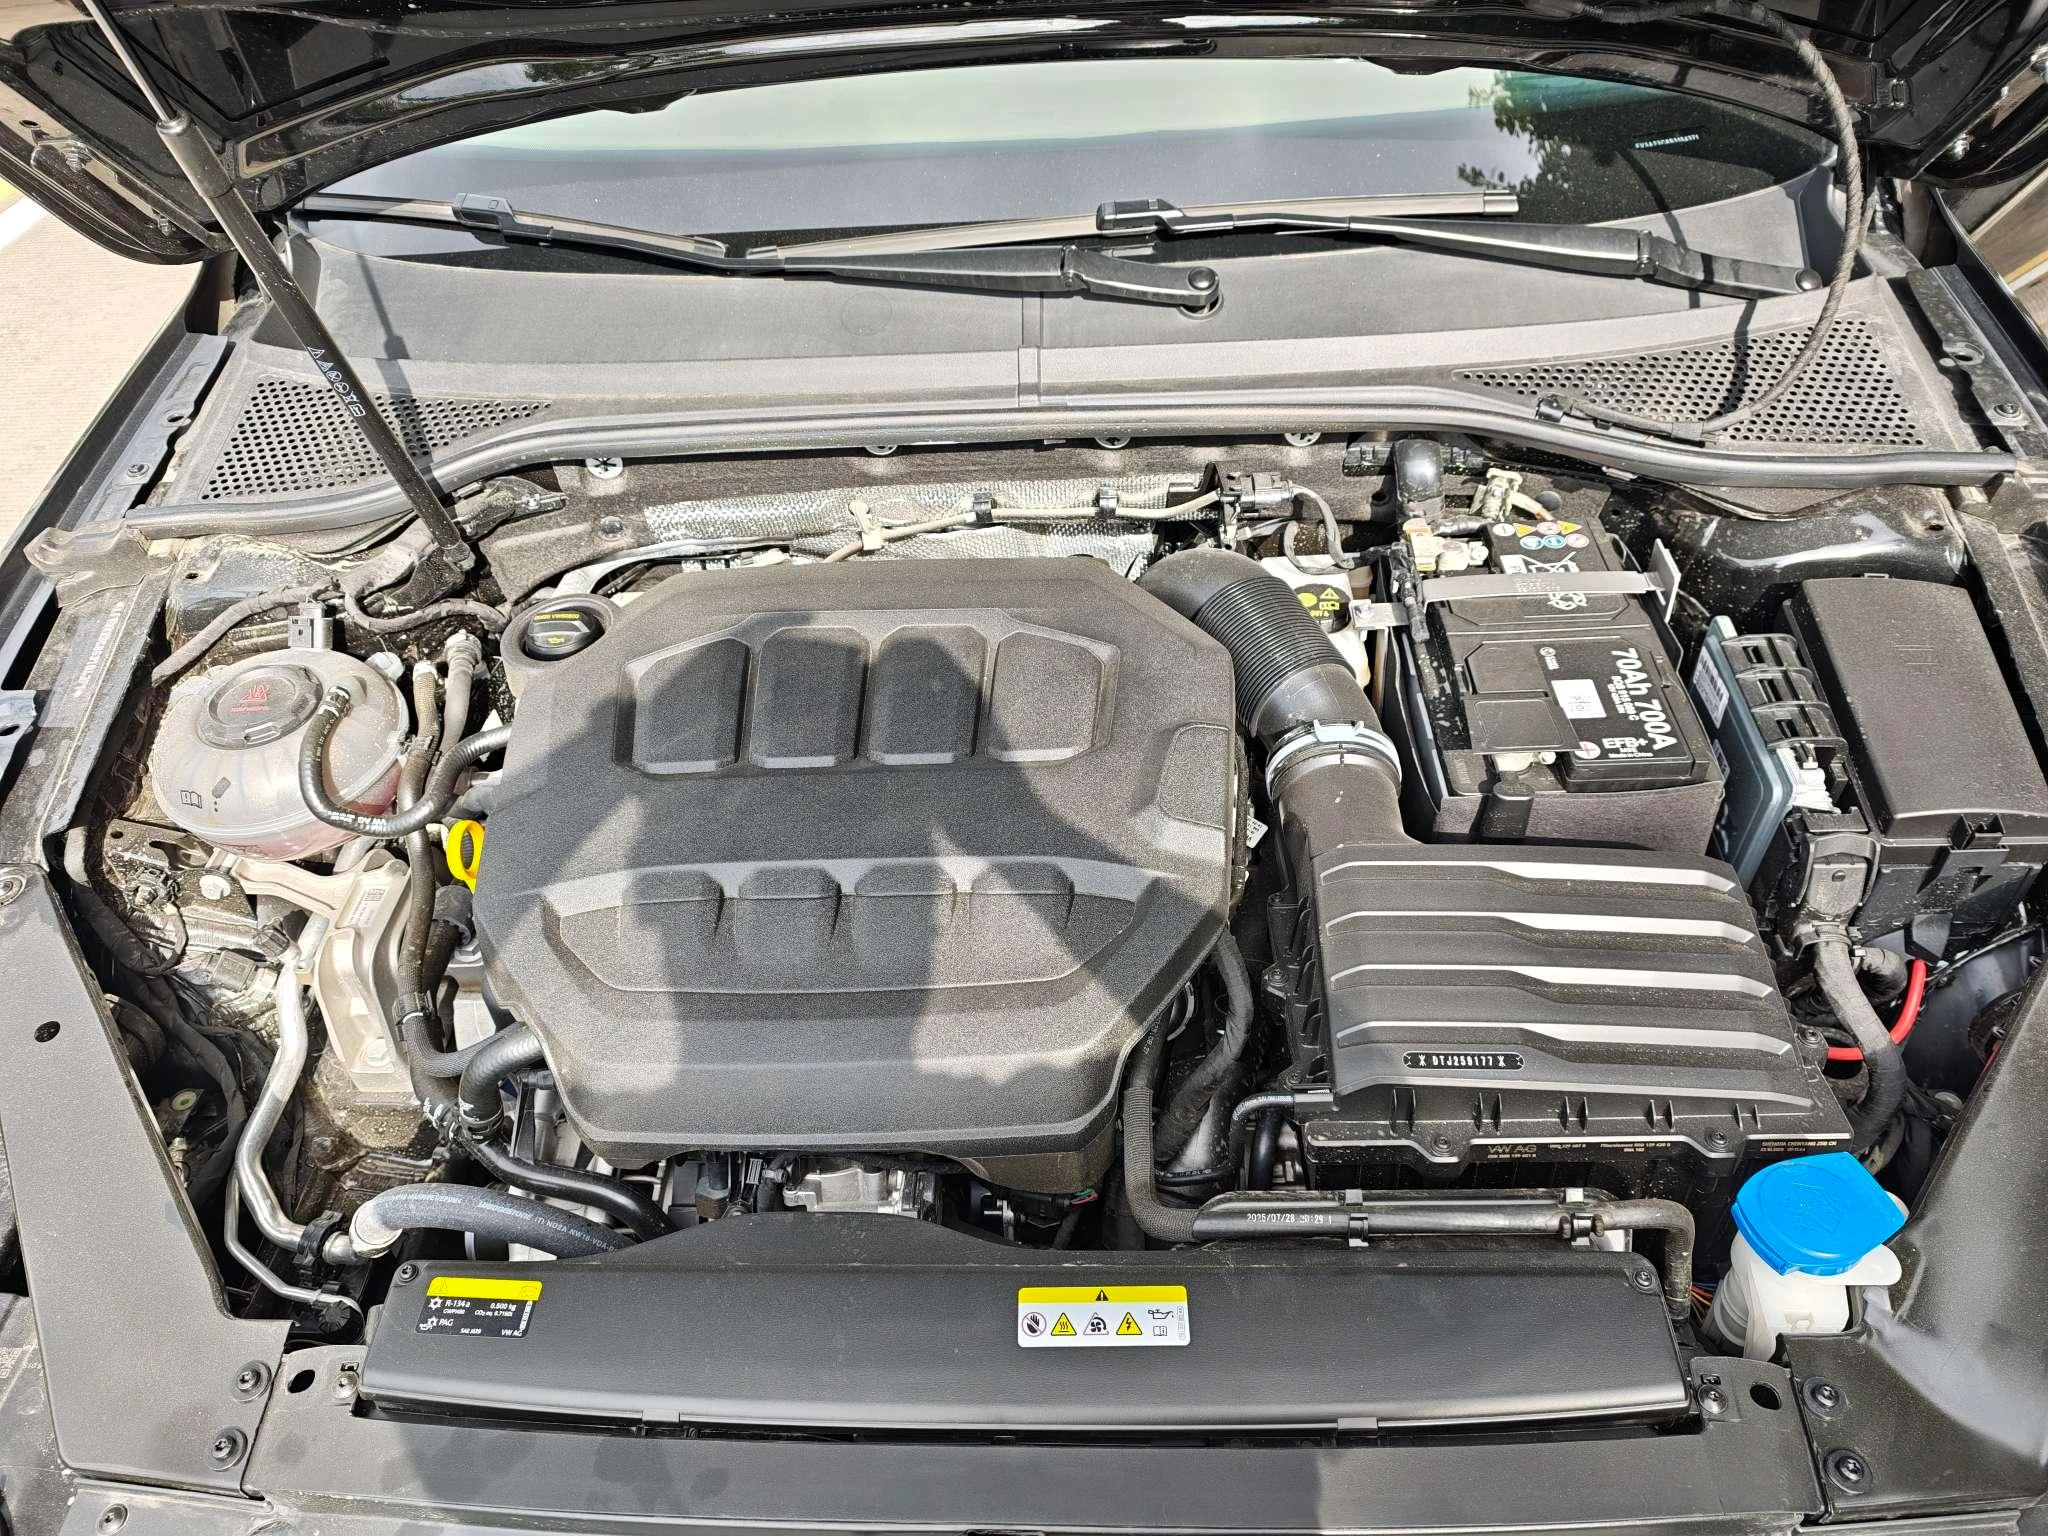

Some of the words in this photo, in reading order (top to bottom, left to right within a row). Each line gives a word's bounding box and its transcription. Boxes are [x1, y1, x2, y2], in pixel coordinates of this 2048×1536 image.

[1611, 648, 1653, 696] 70Ah
[1634, 698, 1678, 751] 700A
[1602, 737, 1649, 749] EFB+
[508, 1303, 517, 1311] kg
[438, 1318, 455, 1326] PAG
[513, 1329, 524, 1337] AG
